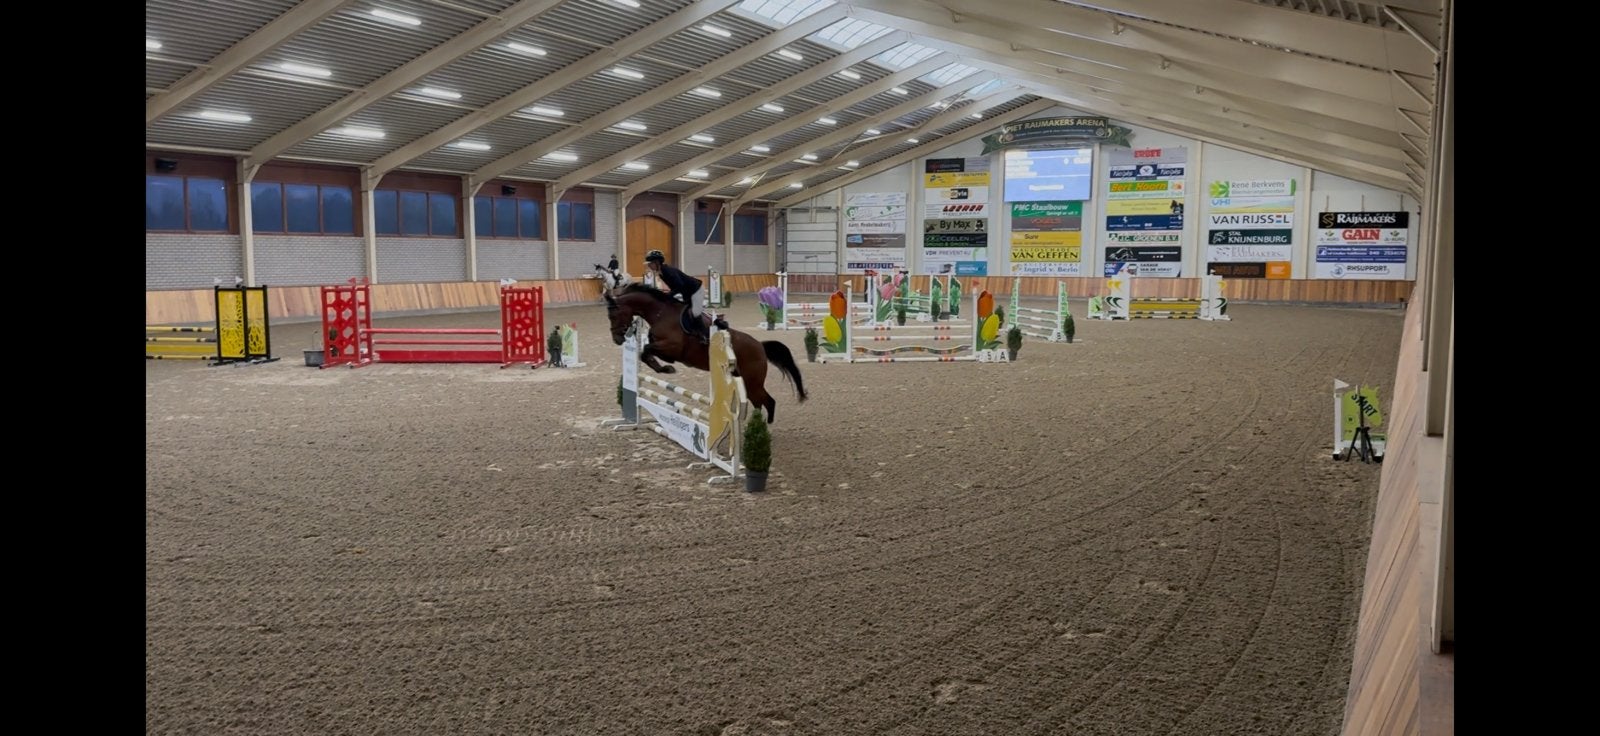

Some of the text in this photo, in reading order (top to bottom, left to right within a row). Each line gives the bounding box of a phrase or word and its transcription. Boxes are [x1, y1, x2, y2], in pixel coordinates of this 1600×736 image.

[1006, 124, 1022, 132] PIET
[1076, 119, 1105, 127] ARENA
[1031, 203, 1069, 211] Staalbouw
[940, 220, 971, 230] By Max
[1212, 215, 1240, 225] VAN
[1342, 229, 1381, 241] GAIN
[1024, 266, 1047, 274] Ingrid
[1351, 393, 1378, 417] START
